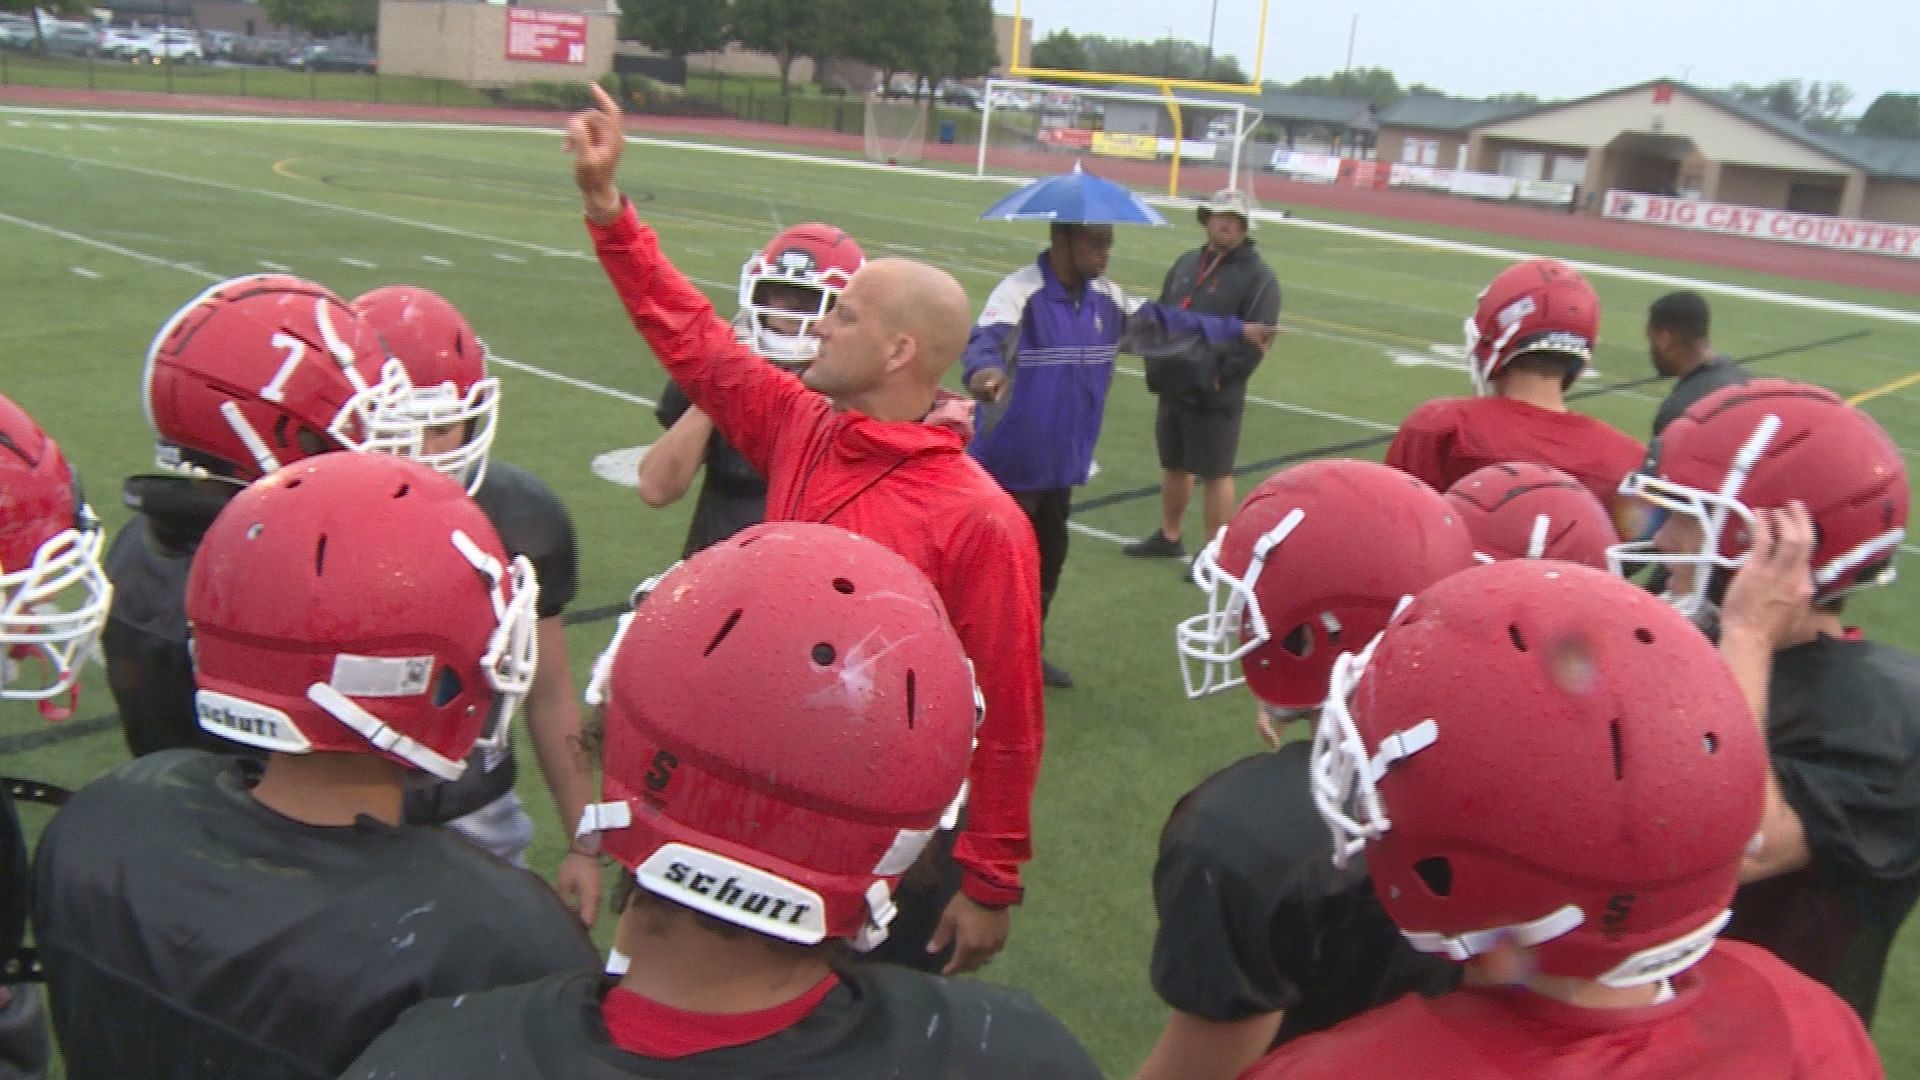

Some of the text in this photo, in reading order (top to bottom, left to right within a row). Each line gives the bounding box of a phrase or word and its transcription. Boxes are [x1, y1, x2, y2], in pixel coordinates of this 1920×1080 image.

[1645, 197, 1697, 224] BIG
[1706, 205, 1762, 234] CAT
[1769, 212, 1920, 254] COUNTRY
[260, 331, 306, 402] 7
[646, 750, 679, 792] S
[664, 860, 810, 925] schutt
